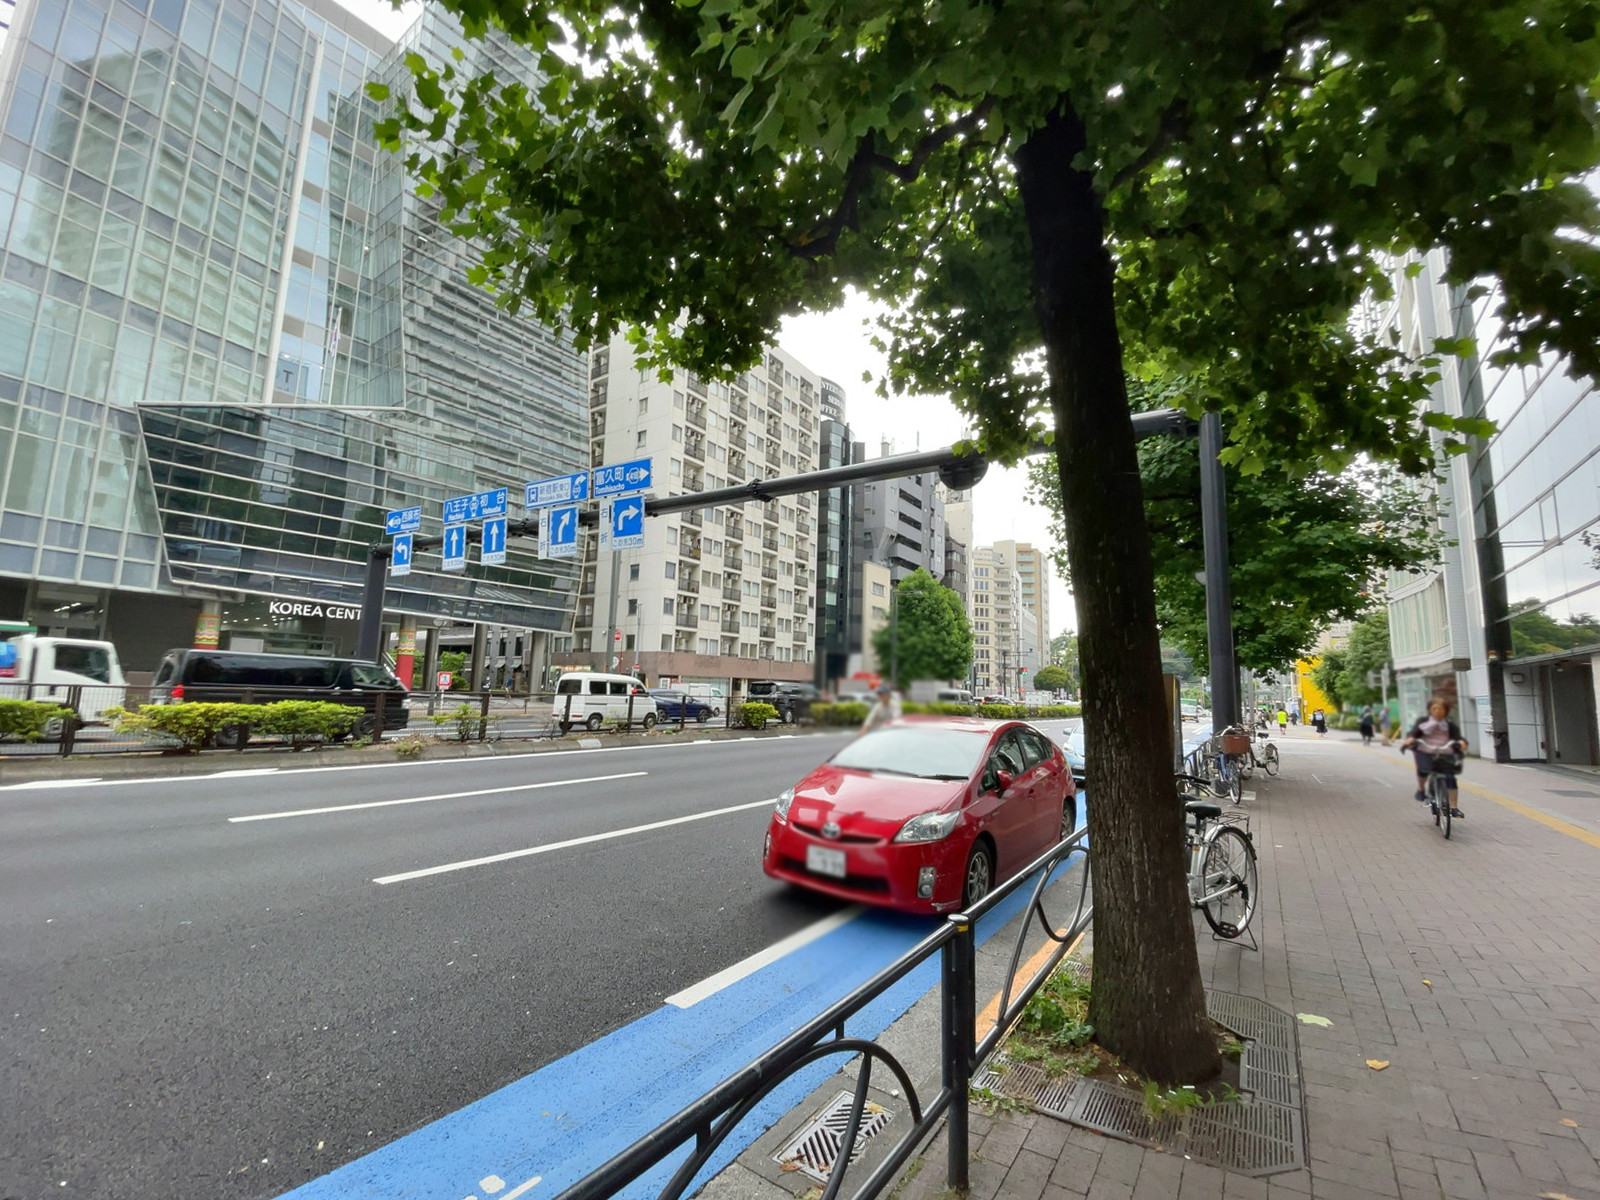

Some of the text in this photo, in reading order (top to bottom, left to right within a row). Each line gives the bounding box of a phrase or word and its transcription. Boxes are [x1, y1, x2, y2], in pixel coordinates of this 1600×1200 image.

[595, 466, 624, 486] 富久町
[445, 498, 469, 515] 八王子
[268, 601, 323, 617] KOREA
